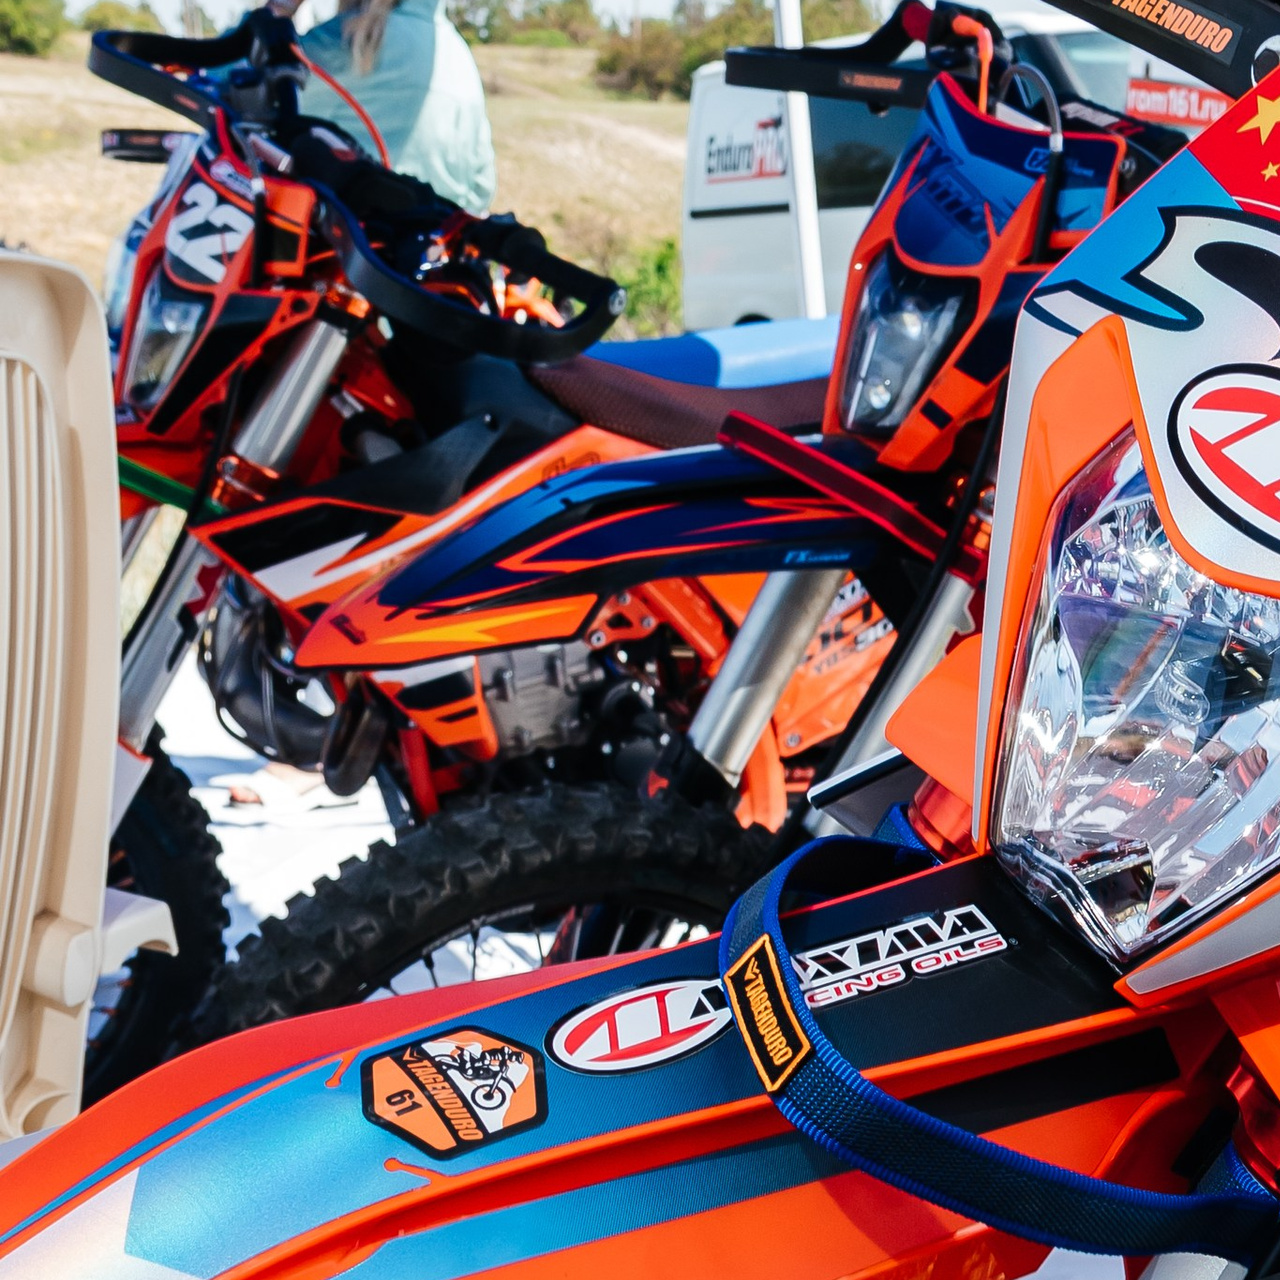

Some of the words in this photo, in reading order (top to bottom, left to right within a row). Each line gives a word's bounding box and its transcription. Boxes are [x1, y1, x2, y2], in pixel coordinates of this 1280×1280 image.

[913, 935, 1005, 970] OILS
[743, 972, 794, 1067] TAGENDURO
[385, 1087, 405, 1120] 61
[402, 1060, 484, 1143] TAGENDURO
